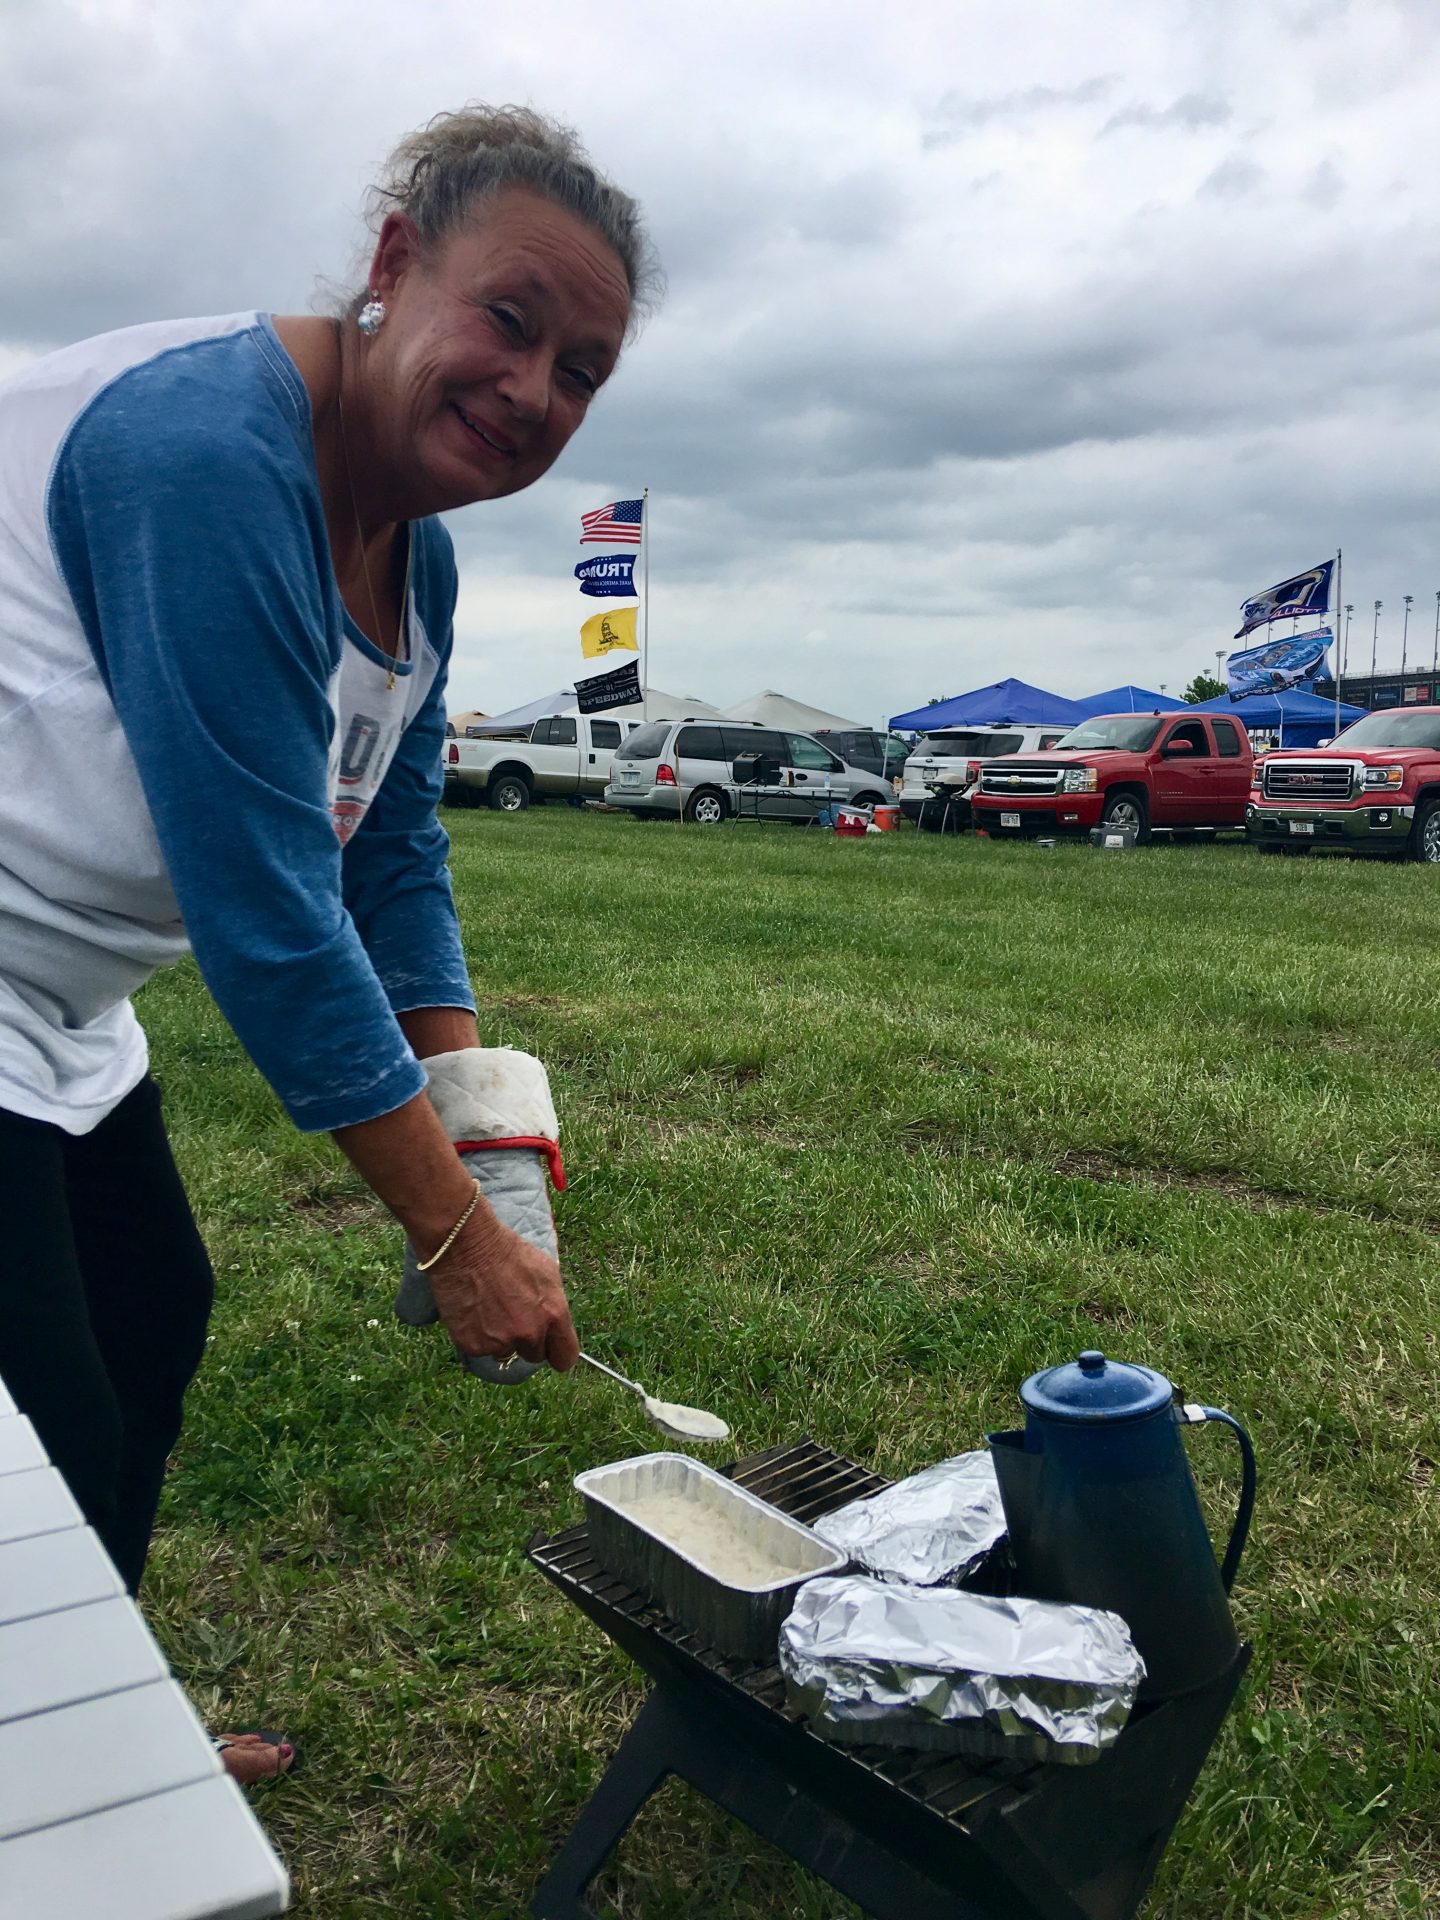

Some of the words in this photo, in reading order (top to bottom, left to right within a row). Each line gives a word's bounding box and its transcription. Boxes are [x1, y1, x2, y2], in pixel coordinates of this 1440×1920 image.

[576, 668, 635, 691] KANSAS
[580, 686, 637, 706] SPEEDWAY
[1288, 775, 1324, 786] GMC
